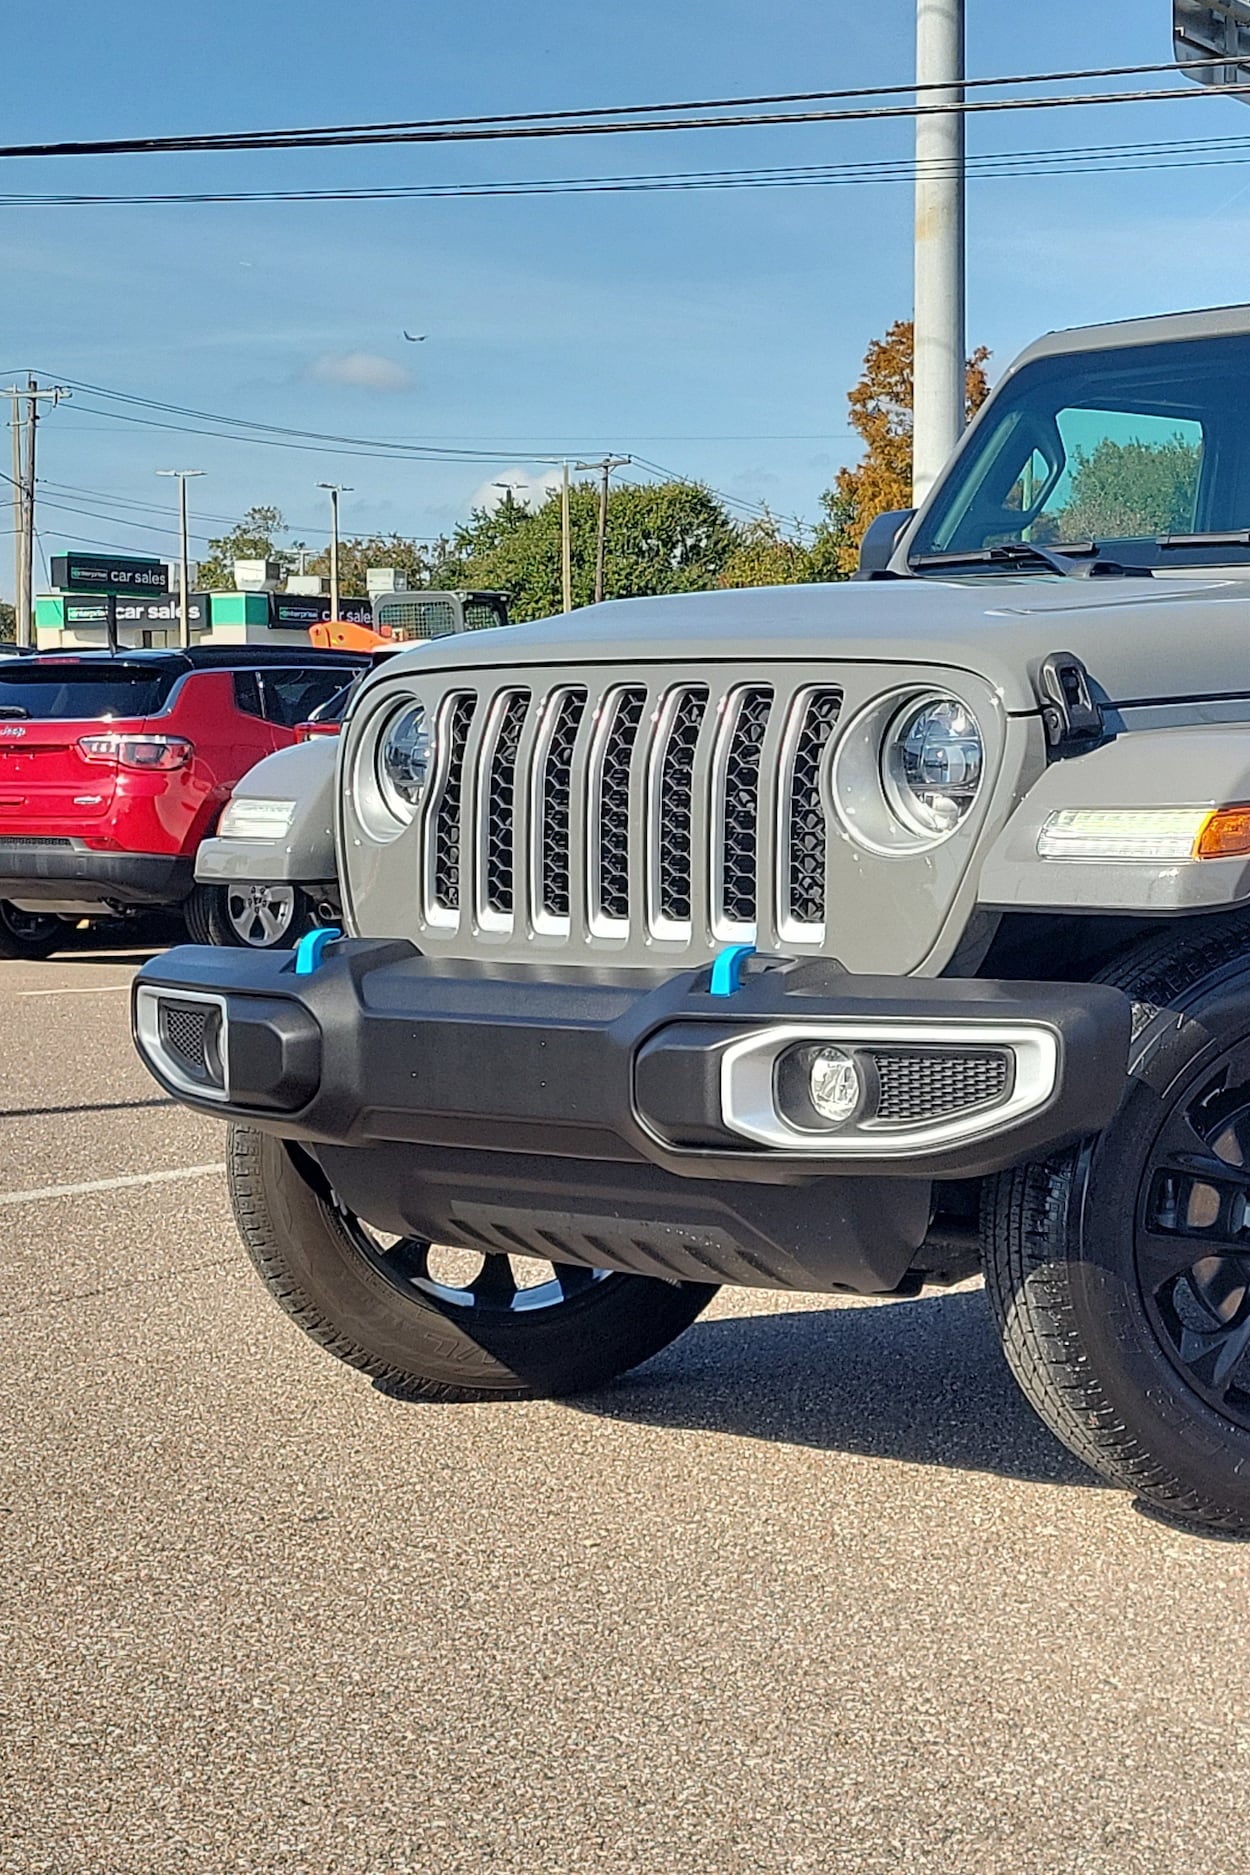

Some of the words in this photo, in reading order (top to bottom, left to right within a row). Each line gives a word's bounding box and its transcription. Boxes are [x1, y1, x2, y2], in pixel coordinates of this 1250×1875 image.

[110, 570, 133, 583] car
[134, 570, 166, 586] sales
[116, 606, 145, 619] car
[321, 610, 345, 621] cr
[346, 606, 372, 623] sale
